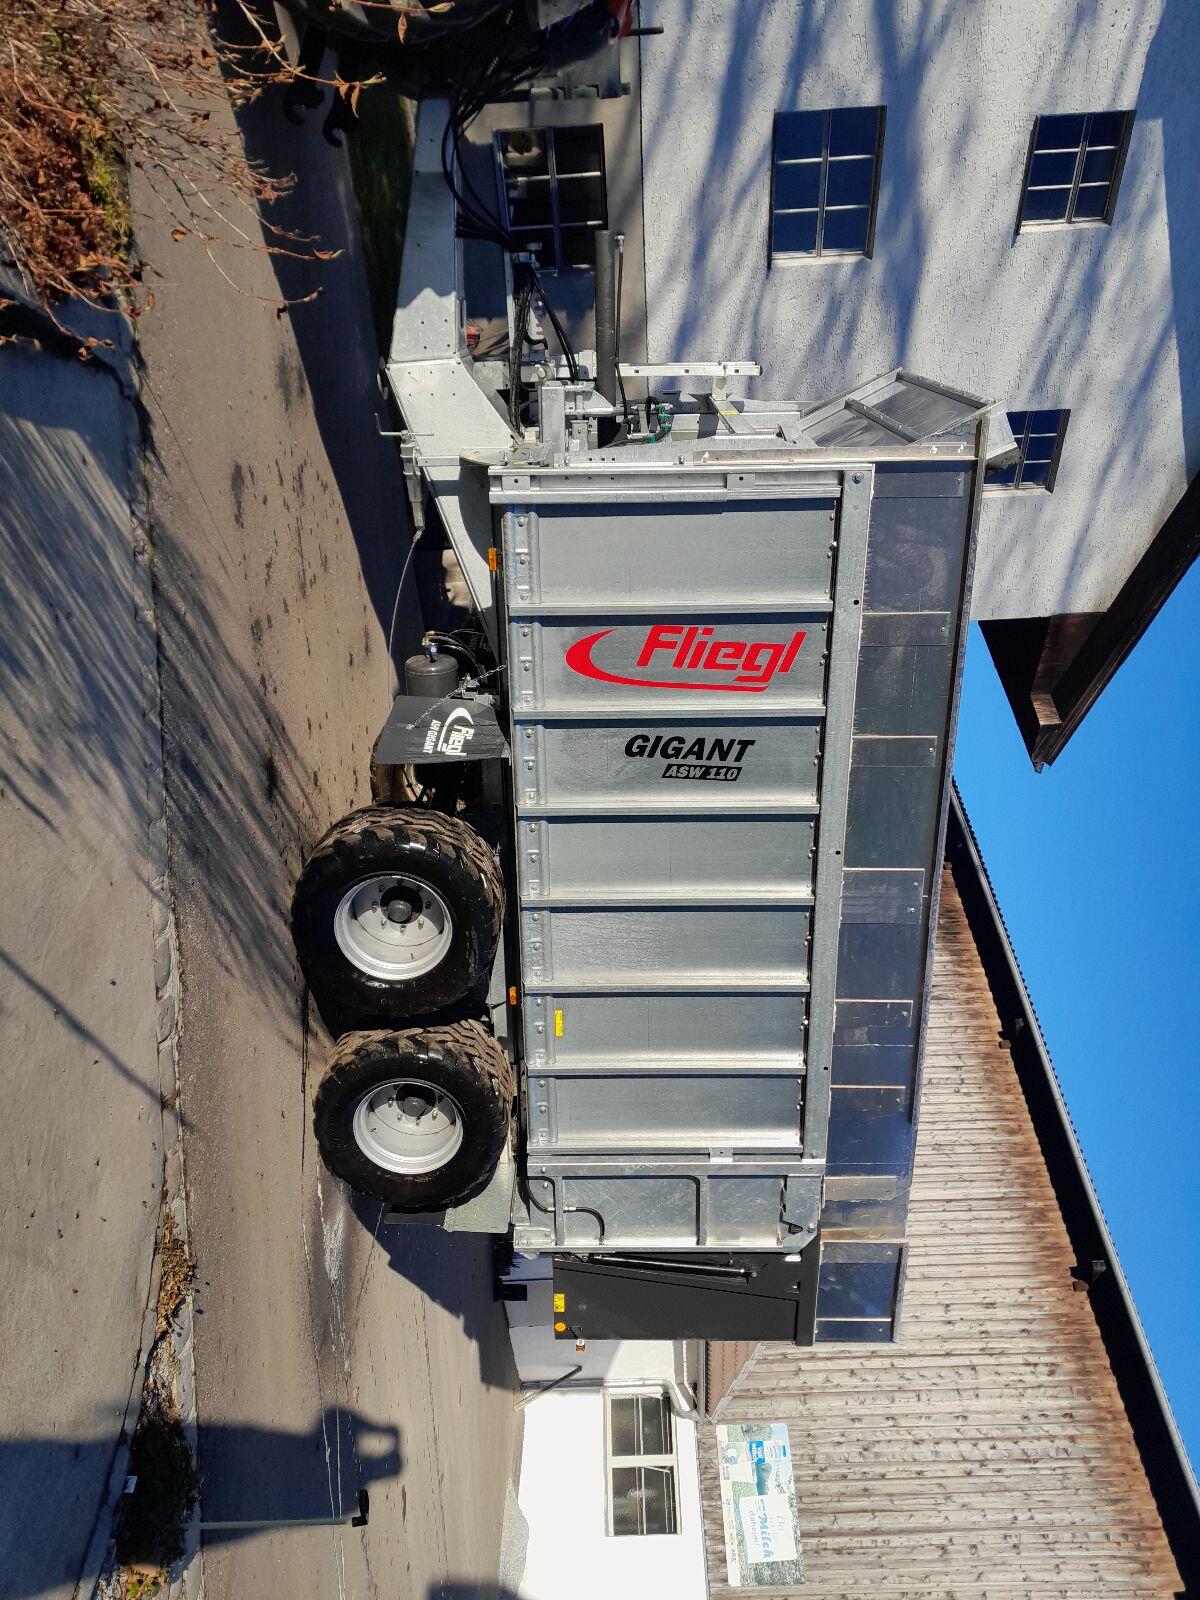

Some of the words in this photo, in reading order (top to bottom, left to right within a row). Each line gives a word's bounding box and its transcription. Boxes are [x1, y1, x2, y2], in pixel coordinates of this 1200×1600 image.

[636, 624, 808, 683] Fliegl
[422, 730, 438, 754] GIGANT
[442, 724, 475, 756] Fliegl
[624, 734, 756, 763] GIGANT
[664, 765, 704, 779] ASW
[707, 766, 738, 780] 110
[758, 1513, 774, 1559] Milch
